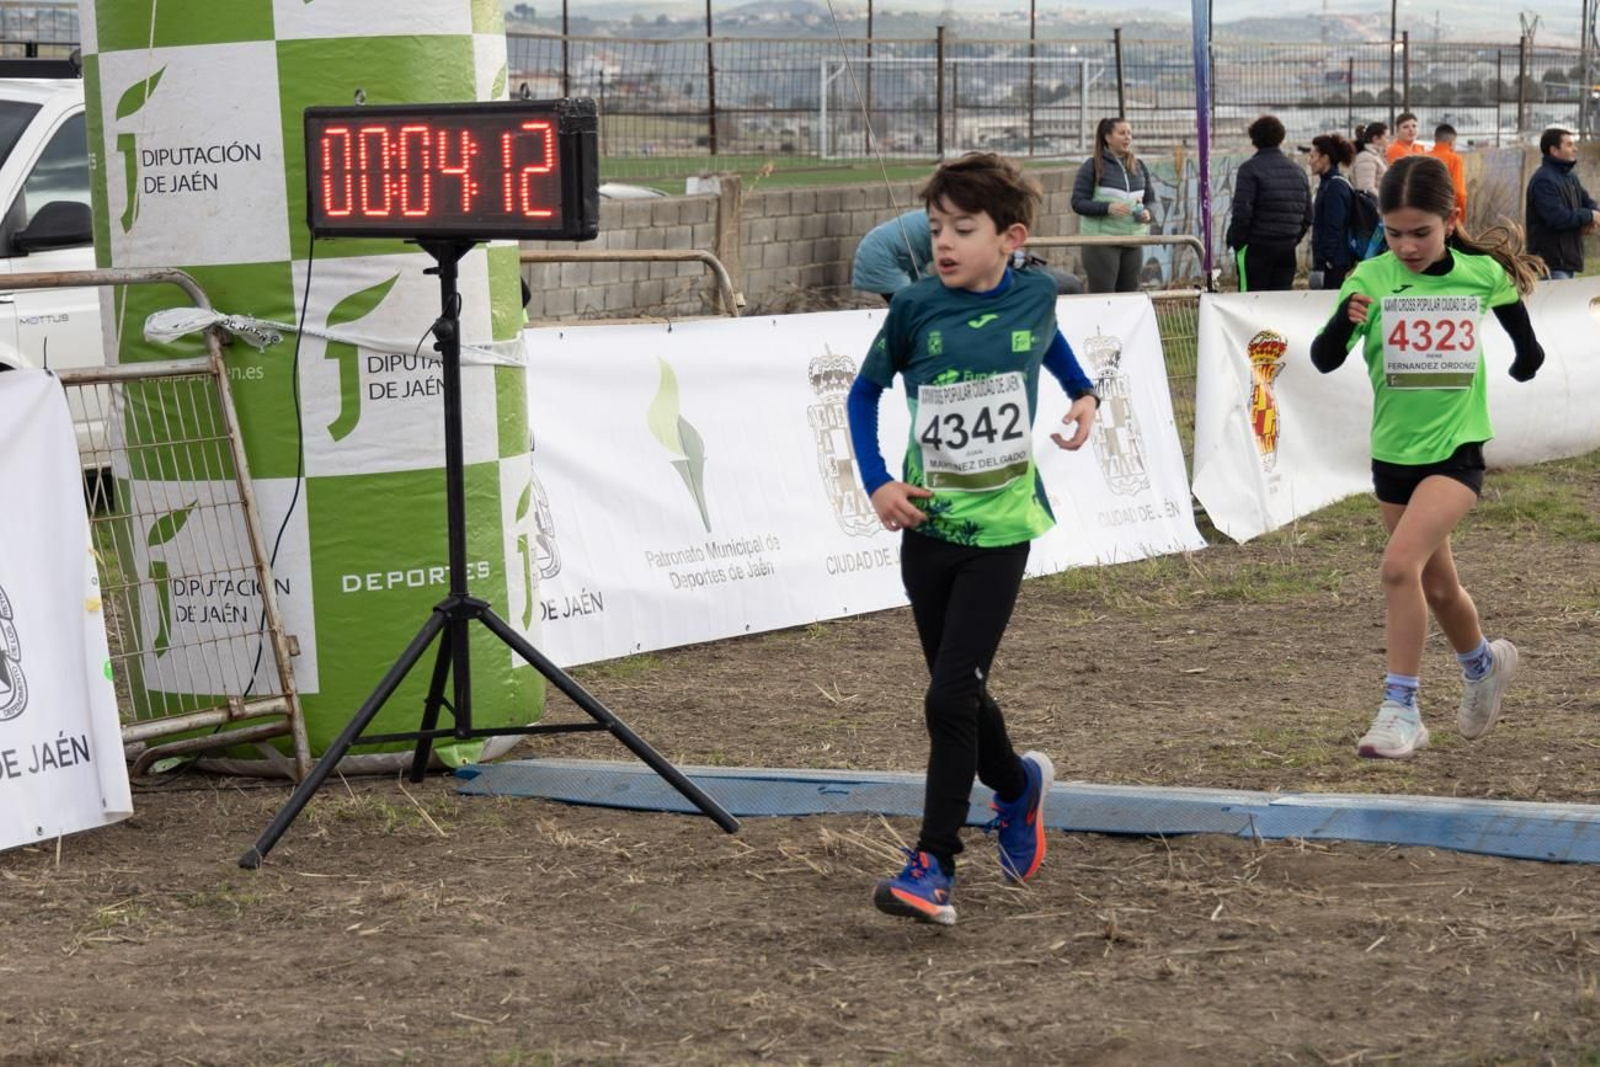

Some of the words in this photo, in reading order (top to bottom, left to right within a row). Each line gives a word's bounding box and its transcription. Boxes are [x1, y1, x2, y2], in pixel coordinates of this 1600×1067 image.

[142, 141, 261, 167] DIPUTACIÓN
[144, 176, 166, 194] DE
[169, 170, 218, 193] JAÉN
[1388, 319, 1475, 352] 4323
[1387, 362, 1438, 370] FERNANDEZ
[369, 382, 398, 400] DE
[921, 402, 1024, 451] 4342
[978, 451, 1027, 469] DELGADO
[645, 546, 705, 568] Patronato
[705, 535, 764, 560] Municipal
[765, 533, 782, 550] de
[826, 551, 873, 575] CIUDAD
[874, 548, 893, 567] DE
[342, 561, 490, 593] DEPORES
[669, 567, 727, 591] Deportes
[728, 562, 745, 581] de
[747, 557, 775, 578] Jaén
[177, 605, 196, 622] DE
[200, 602, 247, 623] JAÉN
[562, 588, 604, 618] JAÉN
[0, 748, 22, 780] E
[28, 730, 91, 774] JAÉN
